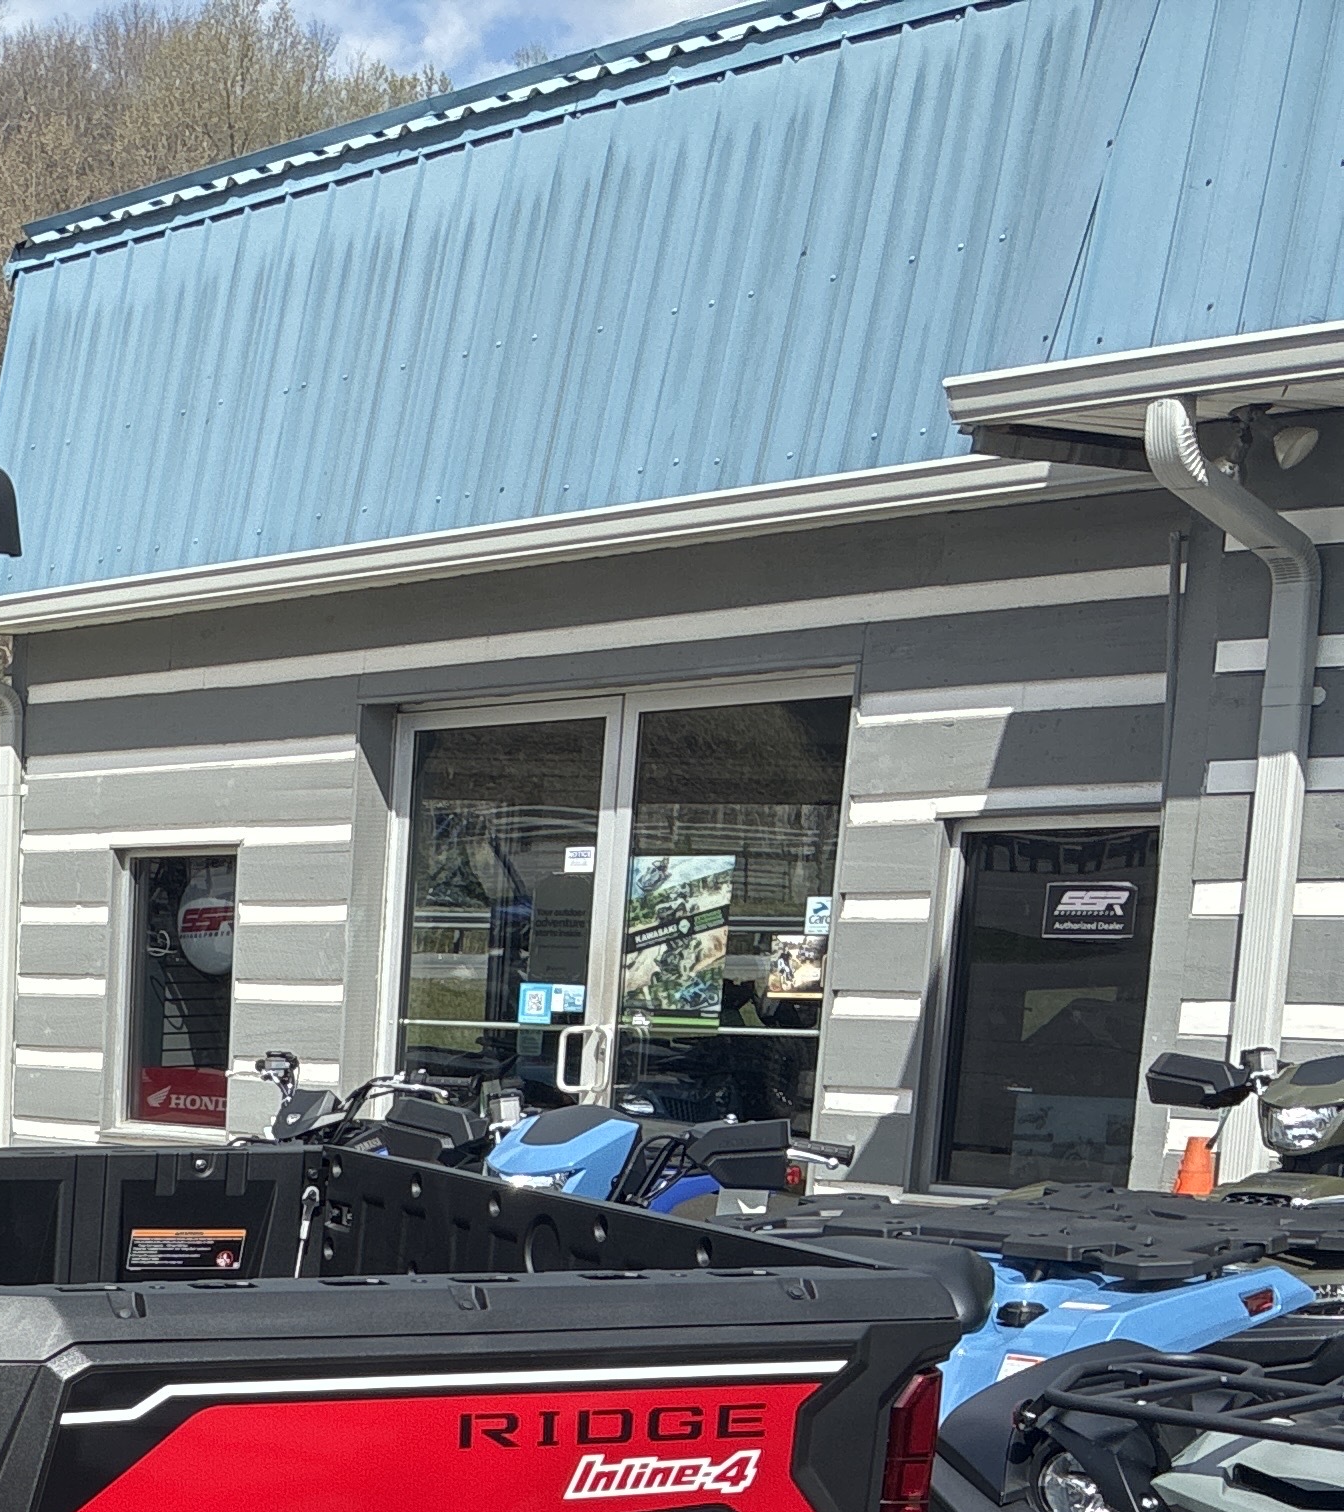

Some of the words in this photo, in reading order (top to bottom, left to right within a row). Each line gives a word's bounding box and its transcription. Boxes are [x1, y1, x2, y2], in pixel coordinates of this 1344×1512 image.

[1056, 890, 1130, 915] SSR
[634, 923, 678, 943] KAWASAKI
[1053, 921, 1097, 930] Authorized
[1098, 921, 1125, 930] Dealer
[458, 1402, 768, 1450] RIDGE
